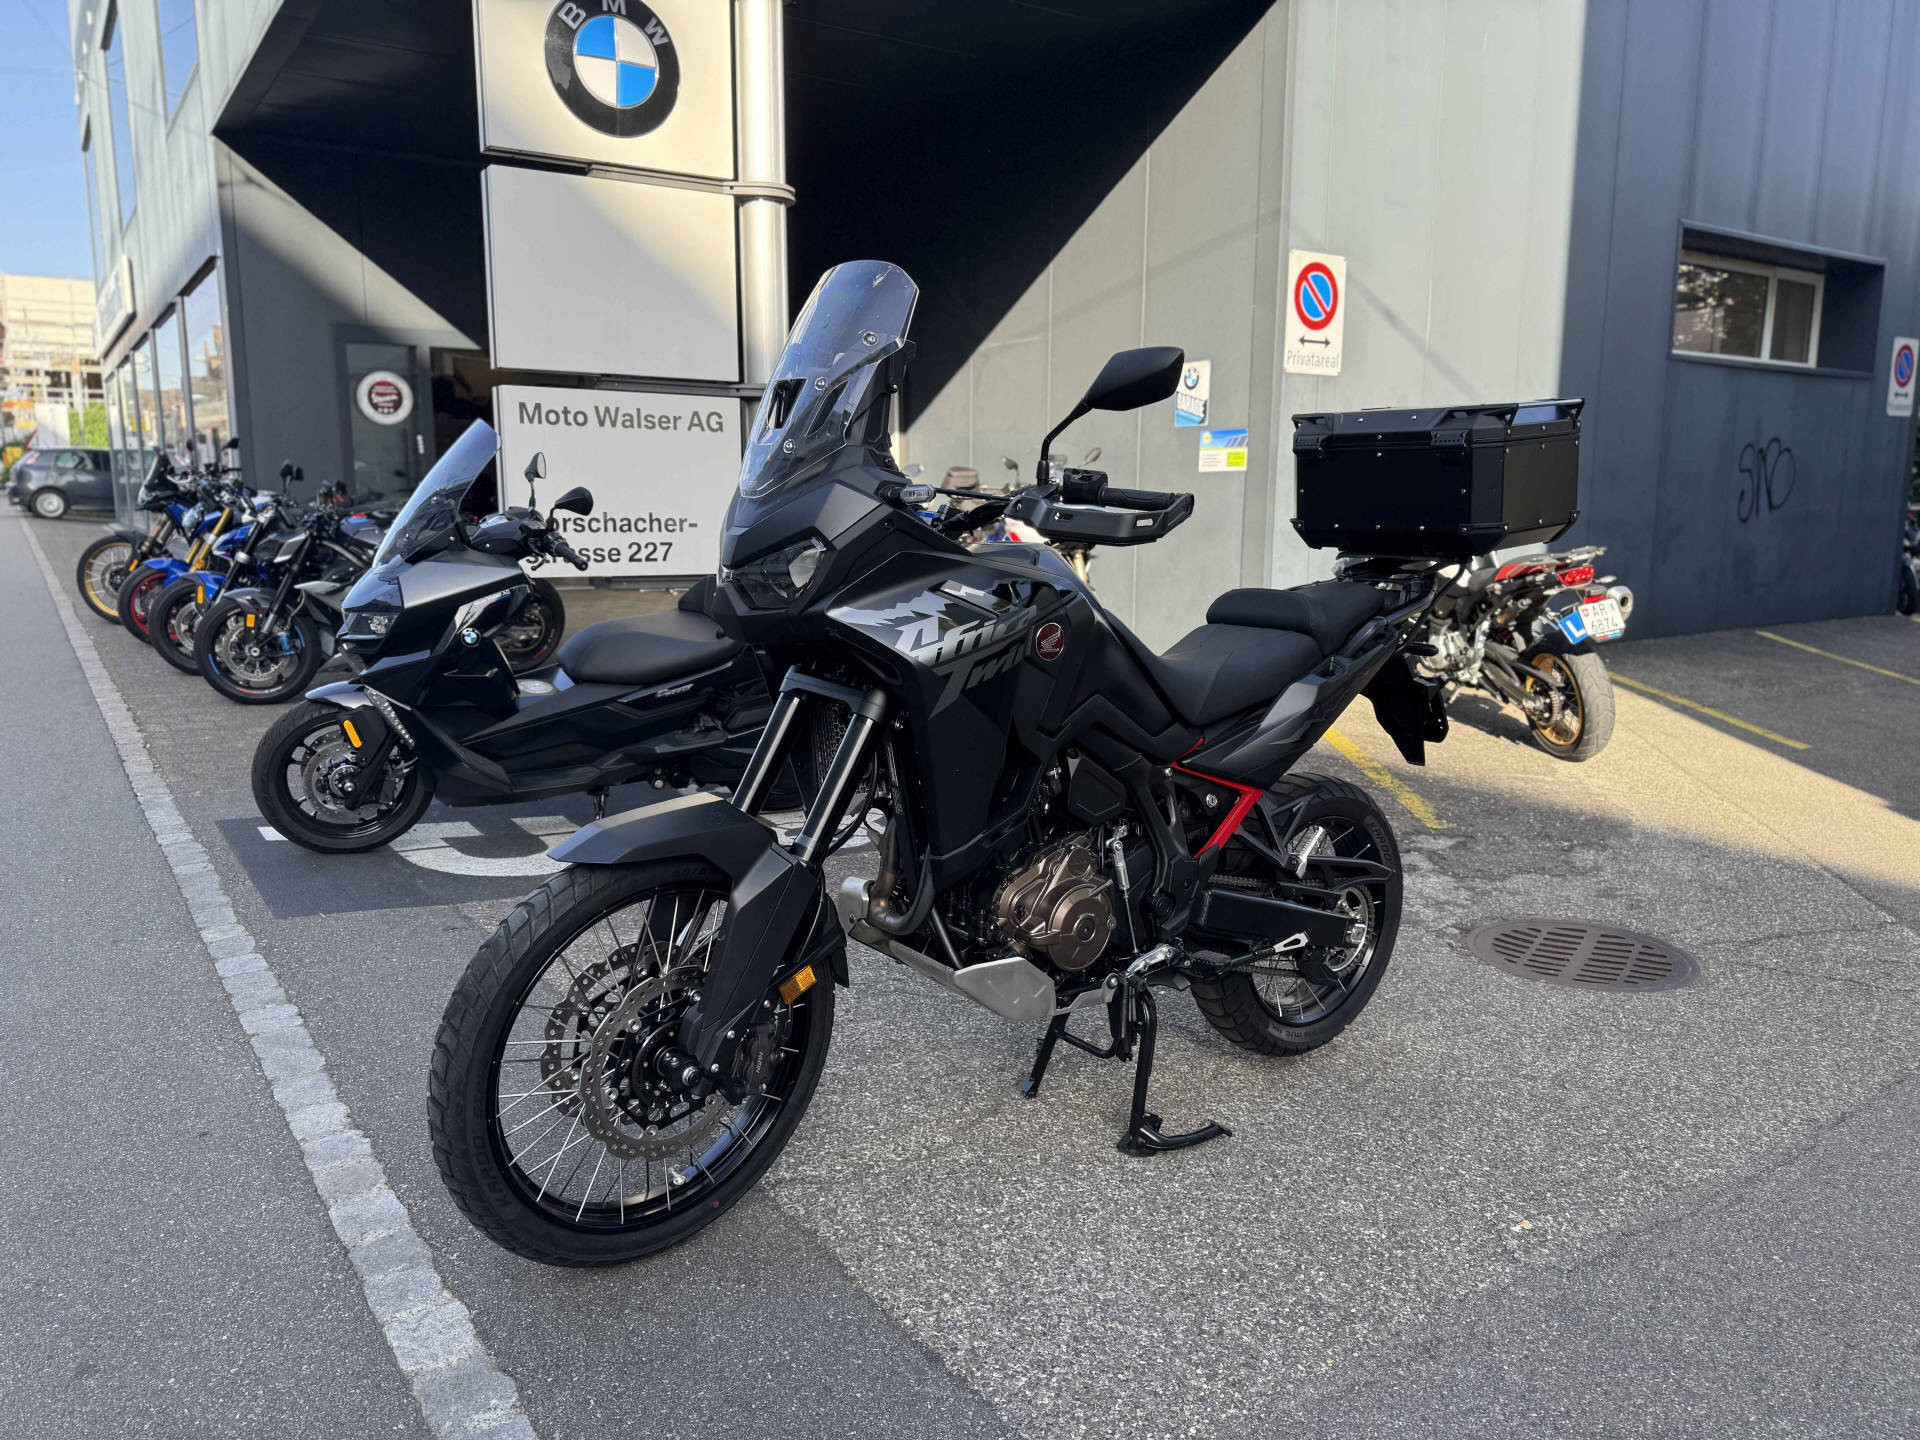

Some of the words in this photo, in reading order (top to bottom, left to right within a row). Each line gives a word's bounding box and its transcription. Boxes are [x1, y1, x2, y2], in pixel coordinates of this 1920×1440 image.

[557, 0, 669, 46] BMW
[1286, 350, 1340, 368] Privatareal
[518, 402, 588, 427] Moto
[594, 405, 682, 431] Walser
[687, 410, 724, 433] AG
[627, 541, 673, 563] 227
[1565, 620, 1586, 638] L
